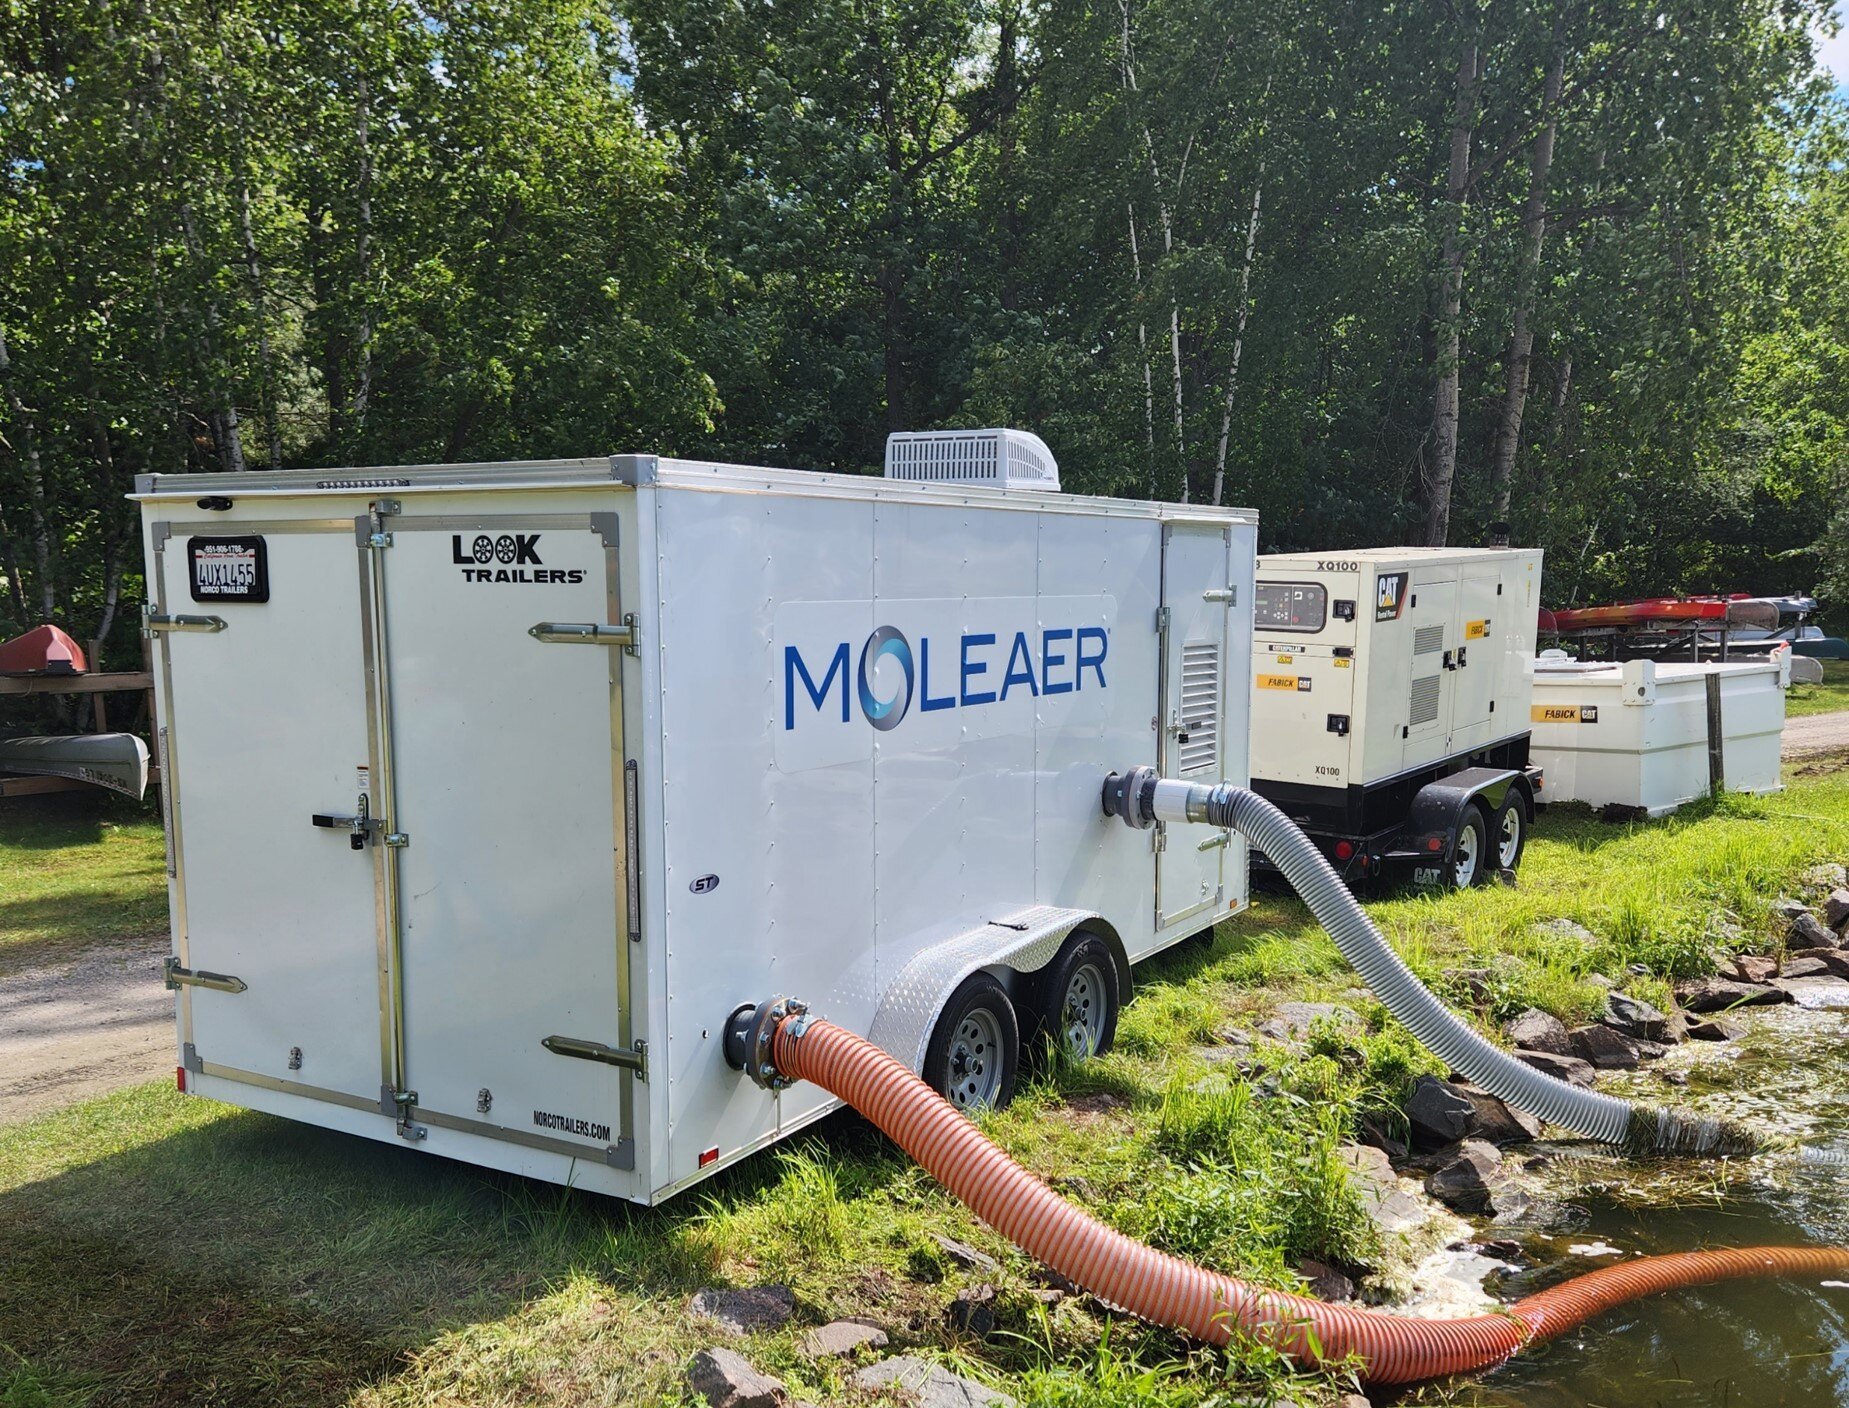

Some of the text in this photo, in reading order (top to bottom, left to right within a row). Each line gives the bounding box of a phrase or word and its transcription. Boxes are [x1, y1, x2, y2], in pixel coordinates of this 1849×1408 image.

[452, 534, 543, 565] LOOK
[1317, 561, 1358, 571] XQ100
[199, 563, 255, 587] 4UX1455
[461, 569, 584, 584] TRAILERS
[1378, 576, 1399, 607] CAT
[785, 625, 1108, 731] MOLEAER
[1268, 678, 1310, 689] FABICK CAT
[1544, 709, 1597, 719] FABICK CAT
[1315, 765, 1340, 776] XQ100
[1413, 866, 1441, 884] CAT
[694, 876, 714, 891] ST
[533, 1110, 611, 1141] NORCOTRAILERS.COM
